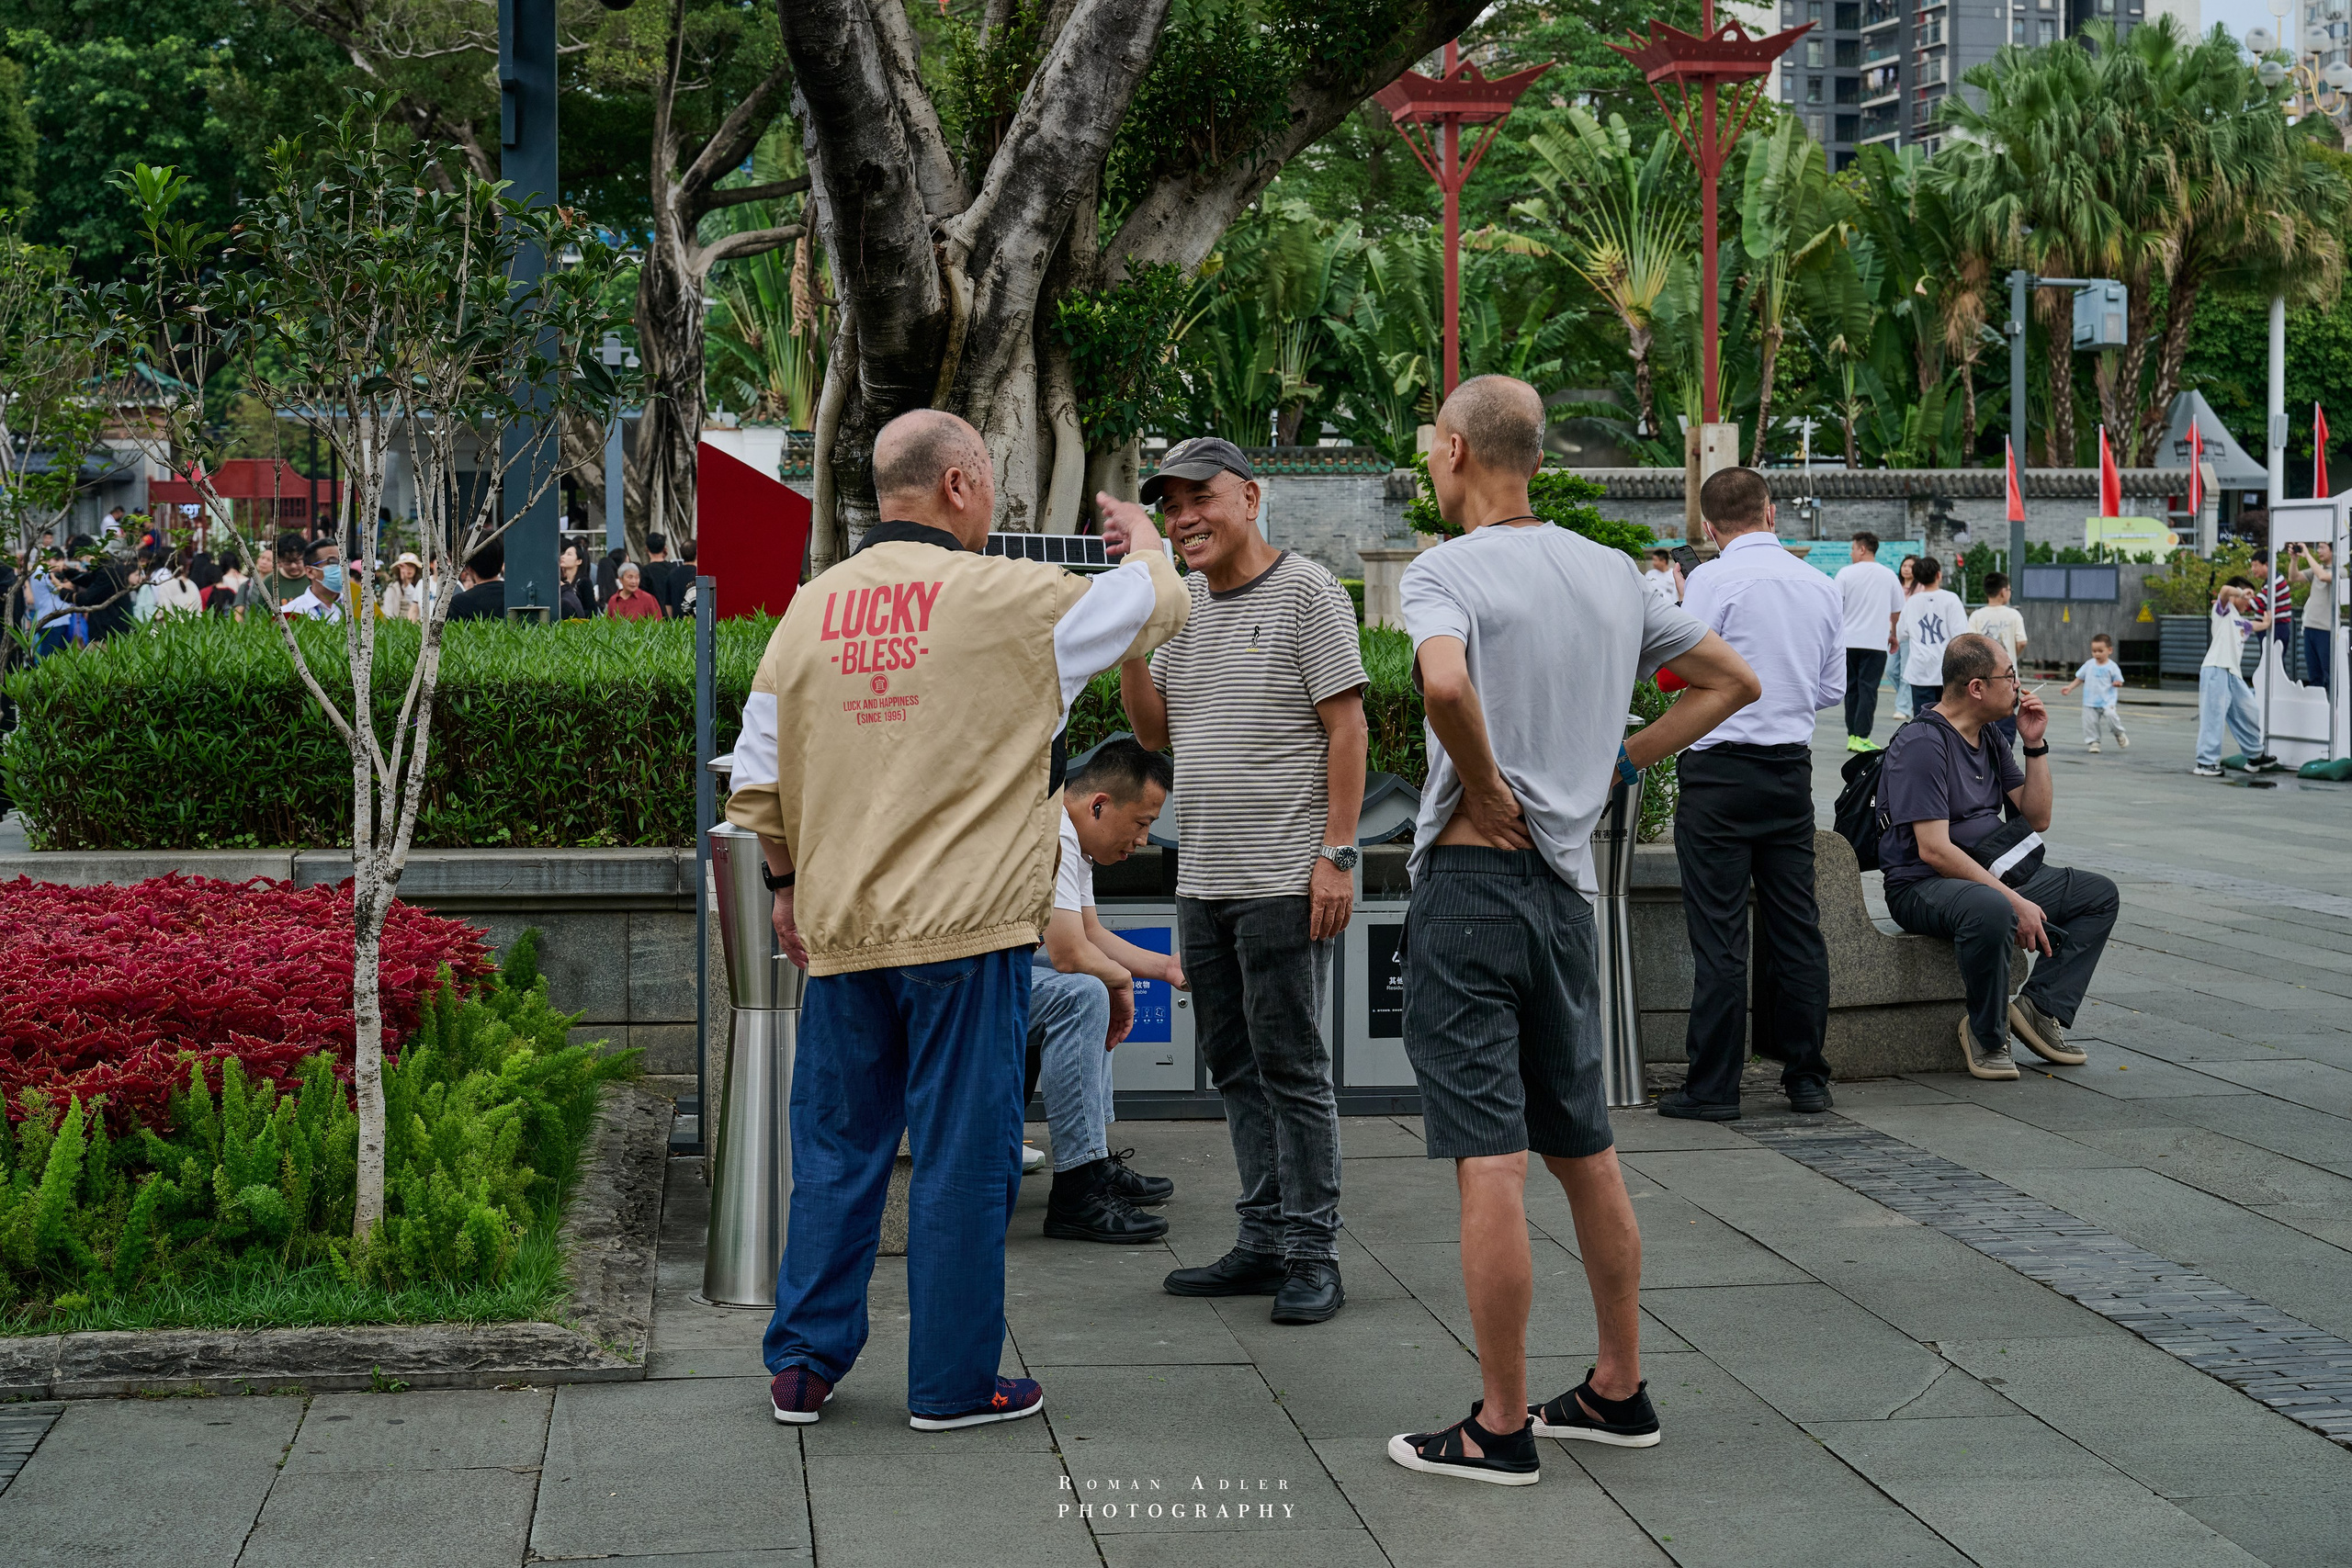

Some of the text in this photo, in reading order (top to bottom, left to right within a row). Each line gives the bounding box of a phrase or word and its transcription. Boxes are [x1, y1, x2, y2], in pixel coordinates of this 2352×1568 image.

[820, 581, 944, 641] LUCKY
[1918, 613, 1945, 645] NY
[843, 694, 920, 712] LUCK AND HAPPINESS
[1132, 980, 1150, 989] 收物
